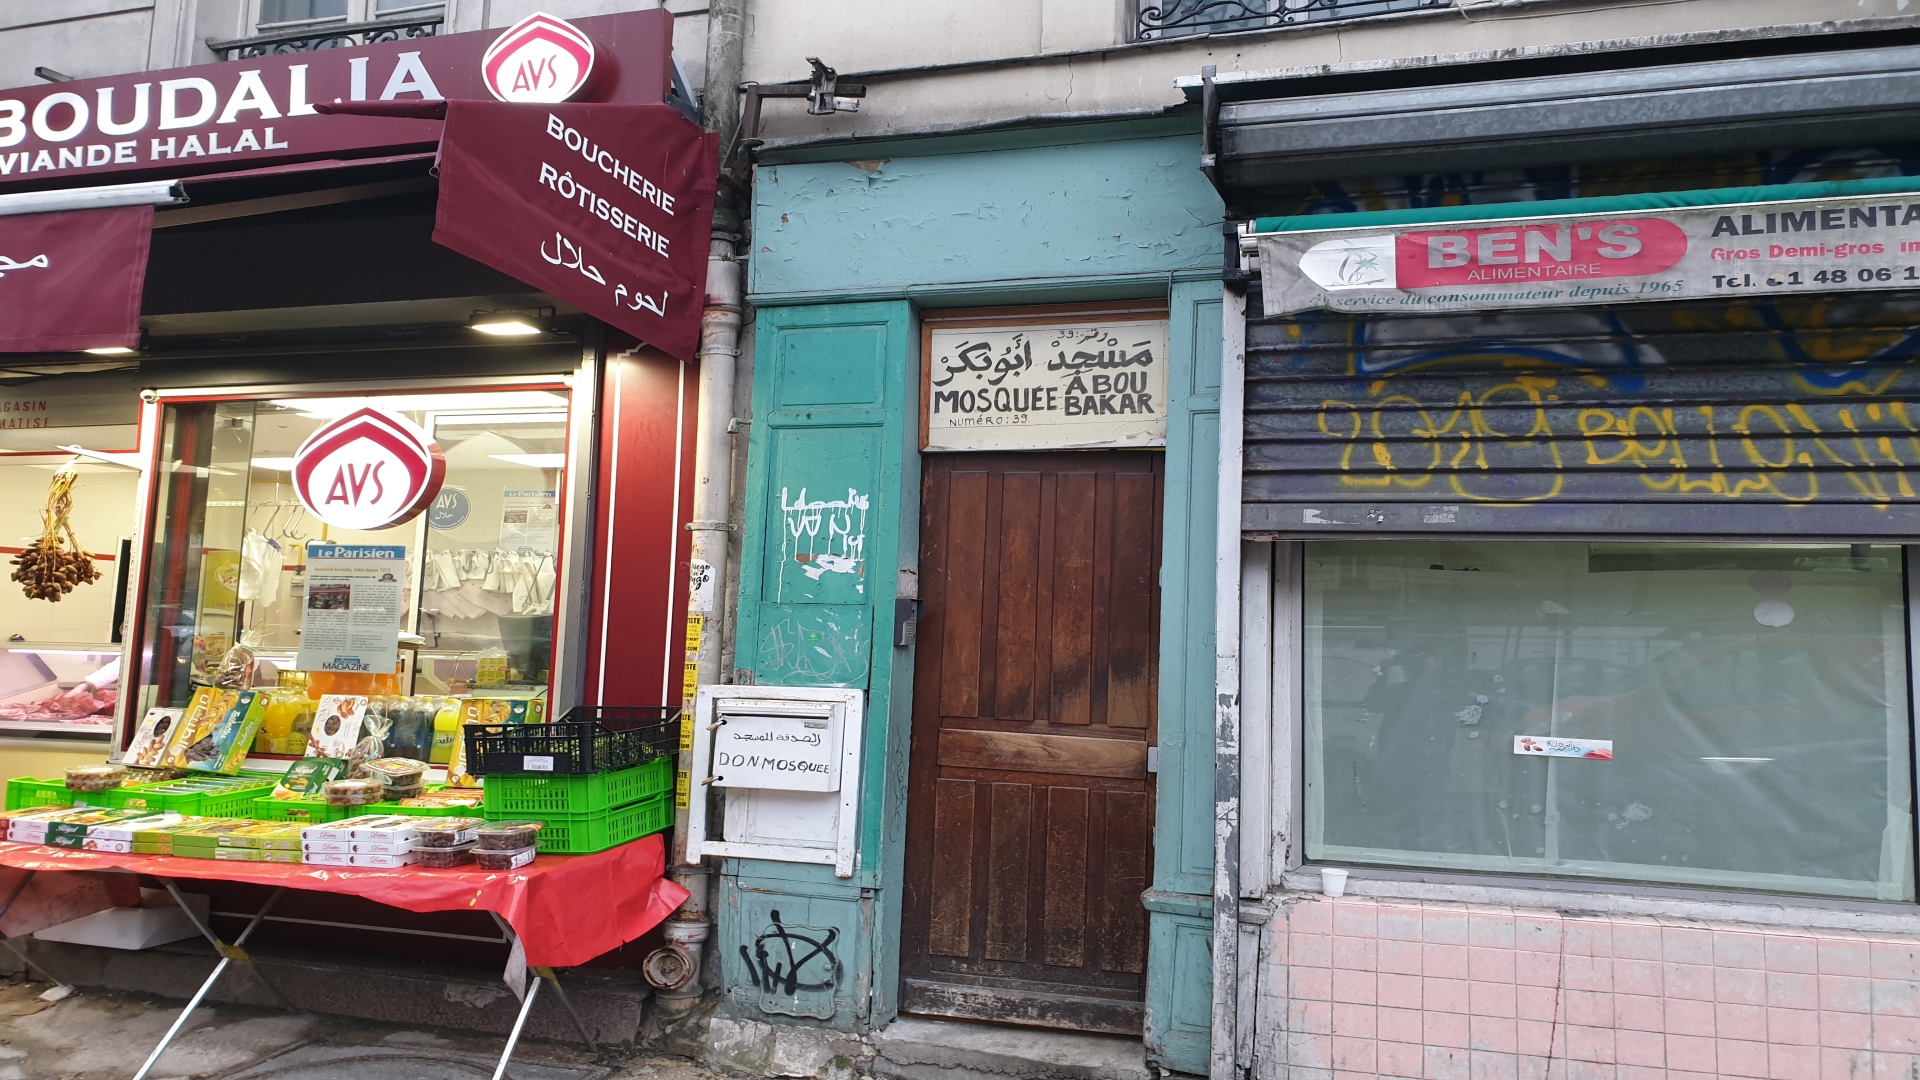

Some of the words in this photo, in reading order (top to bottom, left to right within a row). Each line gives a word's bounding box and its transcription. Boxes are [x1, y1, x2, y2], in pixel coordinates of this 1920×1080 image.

[511, 54, 558, 93] AVS
[0, 51, 445, 147] BOUDALIA
[0, 140, 137, 175] VIANDE
[151, 127, 288, 160] HALAL
[545, 113, 676, 216] BOUCHERIE
[538, 162, 670, 258] RÔTISSERIE
[1711, 204, 1920, 237] ALIMENTA
[540, 231, 607, 285] حلال
[1427, 223, 1643, 269] BEN'S
[1711, 246, 1761, 261] Gros
[1769, 242, 1885, 259] Demi-gros
[1467, 263, 1601, 281] ALIMENTAIRE
[1813, 269, 1848, 284] 48
[1857, 267, 1892, 282] 06
[612, 283, 669, 317] لحوم
[1336, 297, 1395, 307] service
[1400, 292, 1422, 305] du
[1428, 289, 1560, 304] consommateur
[1569, 284, 1630, 299] depuis
[1637, 280, 1684, 294] 1965
[1065, 371, 1148, 395] ABOU
[0, 400, 47, 413] GASIN
[1064, 393, 1155, 416] BAKAR
[325, 460, 385, 507] AVS
[436, 493, 458, 509] AVS
[435, 510, 454, 520] حلال
[318, 548, 333, 558] Le
[335, 546, 395, 559] Parisien
[322, 662, 370, 672] MAGAZINE
